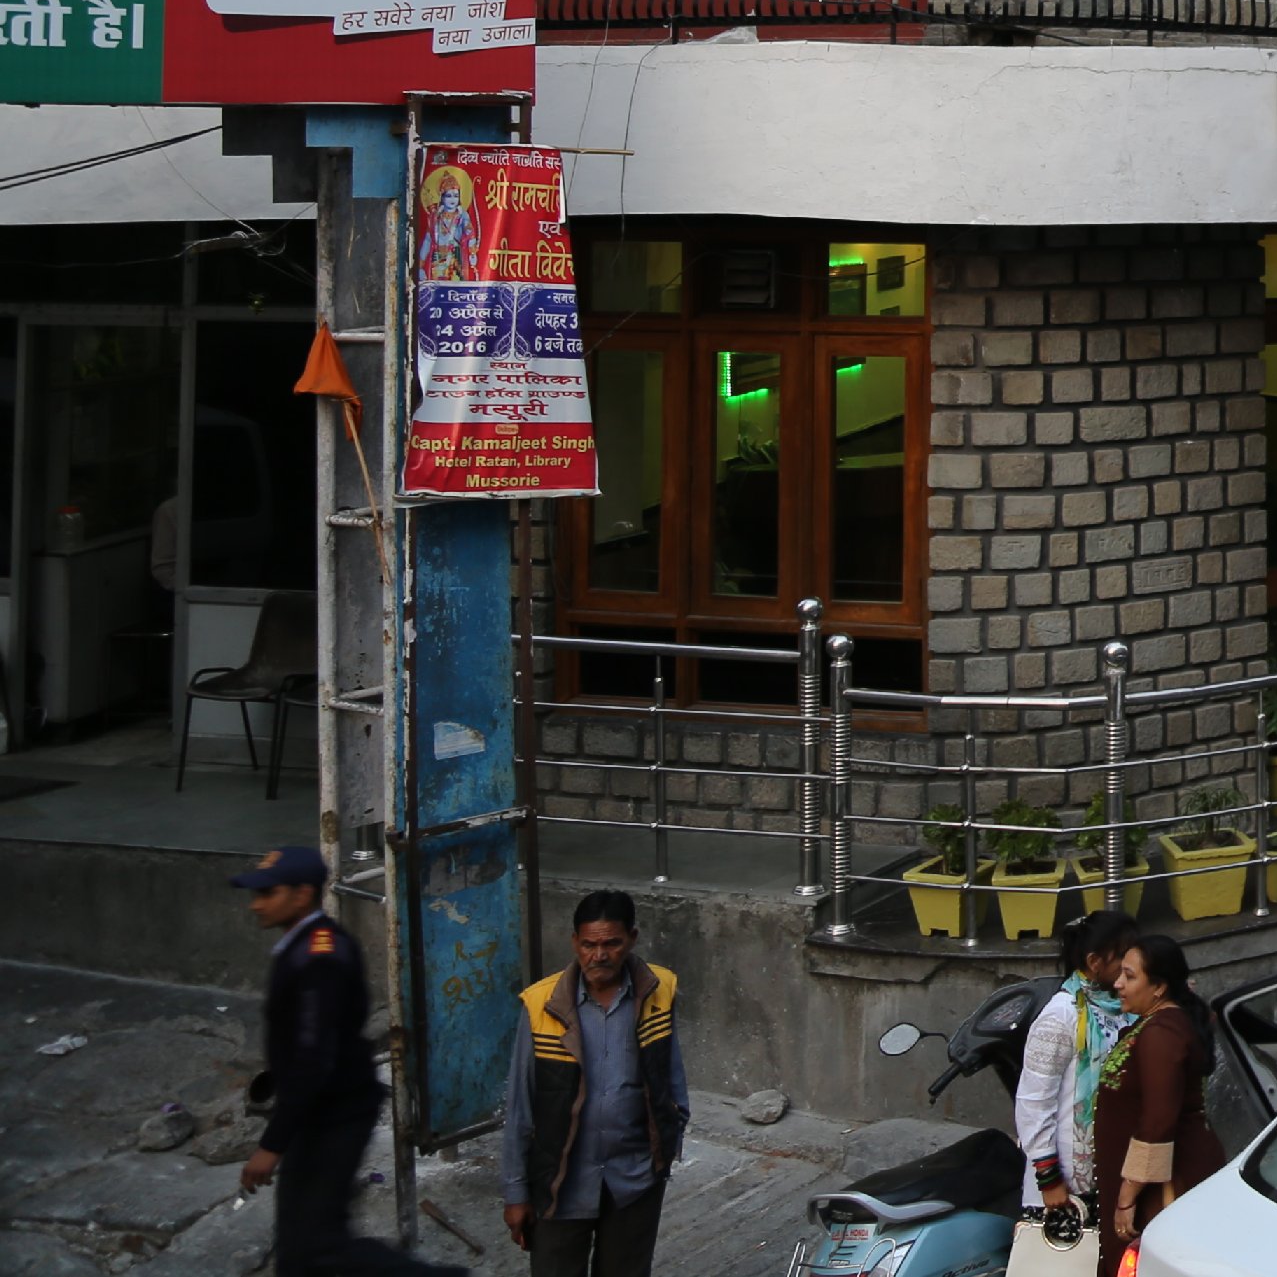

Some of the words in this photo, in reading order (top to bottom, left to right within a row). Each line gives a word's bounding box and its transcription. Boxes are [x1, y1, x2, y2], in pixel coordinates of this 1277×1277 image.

[342, 10, 367, 30] हर
[374, 2, 415, 27] सवेरे
[421, 5, 456, 22] नया
[438, 29, 471, 46] नया
[481, 23, 535, 43] उजाला
[485, 168, 510, 210] श्री
[488, 237, 532, 278] गीता
[429, 307, 442, 318] 20
[493, 304, 504, 319] से
[535, 308, 567, 330] दोपहर
[570, 313, 578, 329] 3
[438, 341, 487, 353] 2016
[534, 334, 542, 352] 6
[545, 333, 565, 352] बजे
[489, 361, 528, 370] स्थान
[432, 374, 489, 385] नगर
[495, 371, 582, 386] पालिका
[425, 390, 481, 399] टाउन
[468, 399, 550, 421] मसूरी
[411, 435, 456, 453] Capt.
[461, 436, 547, 453] Kamaljeet
[551, 435, 595, 453] Singh
[435, 456, 471, 467] Hotel
[475, 456, 521, 469] Ratan,
[524, 455, 572, 469] Library
[466, 474, 540, 488] Mussorie
